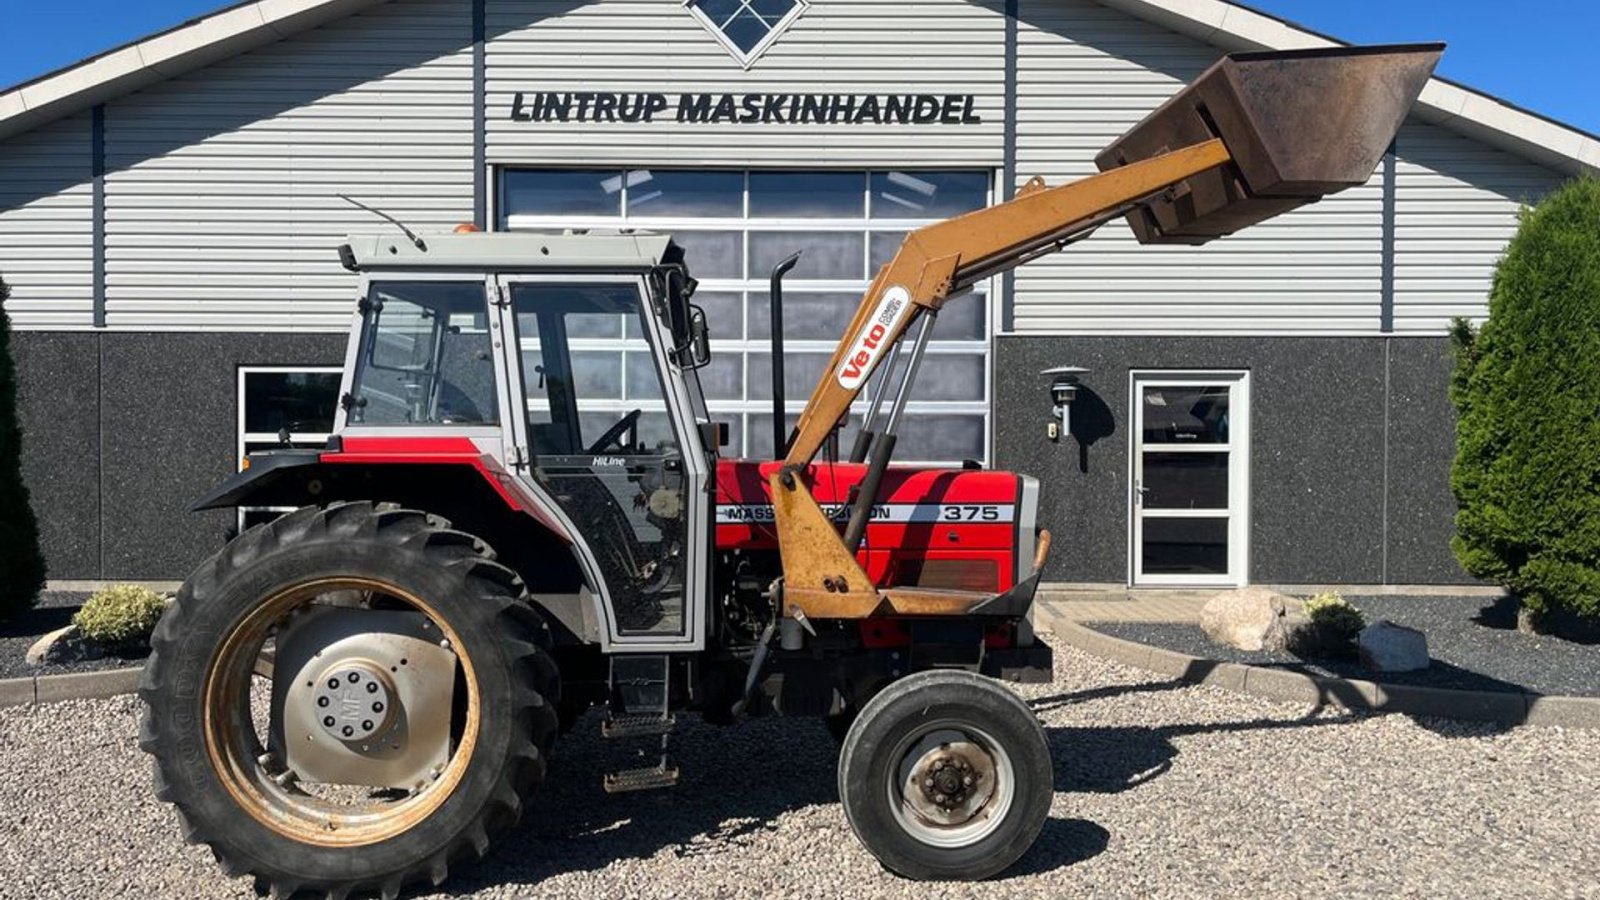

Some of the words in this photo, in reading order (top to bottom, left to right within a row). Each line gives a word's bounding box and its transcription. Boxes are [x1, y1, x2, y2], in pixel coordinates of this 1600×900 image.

[511, 92, 668, 122] LINTRUP
[677, 93, 982, 124] MASKINHANDEL
[592, 456, 626, 466] HiLine
[728, 507, 775, 520] MASS
[944, 506, 999, 520] 375
